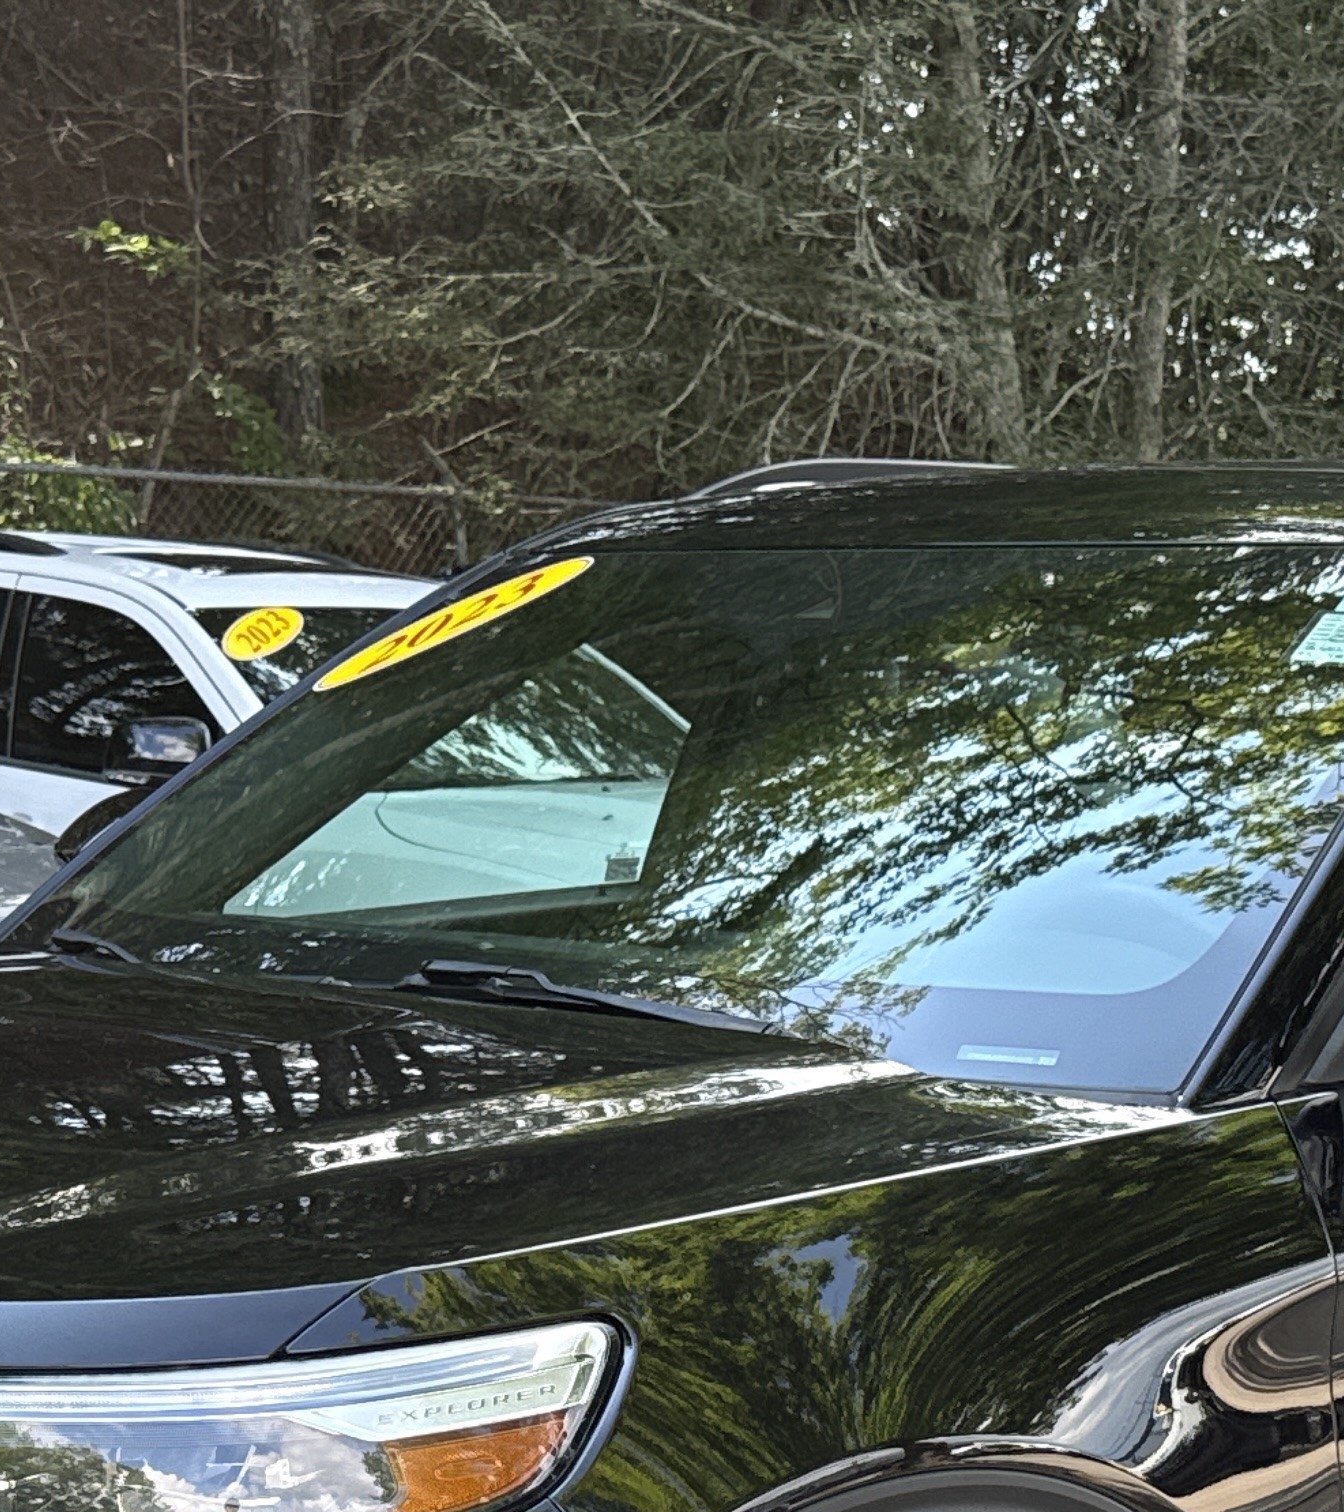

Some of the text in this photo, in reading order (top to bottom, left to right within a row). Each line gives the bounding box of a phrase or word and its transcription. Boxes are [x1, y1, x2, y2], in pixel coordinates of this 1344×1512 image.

[235, 610, 291, 653] 2023
[356, 572, 545, 676] 2023
[377, 1383, 557, 1426] EXPLORER
